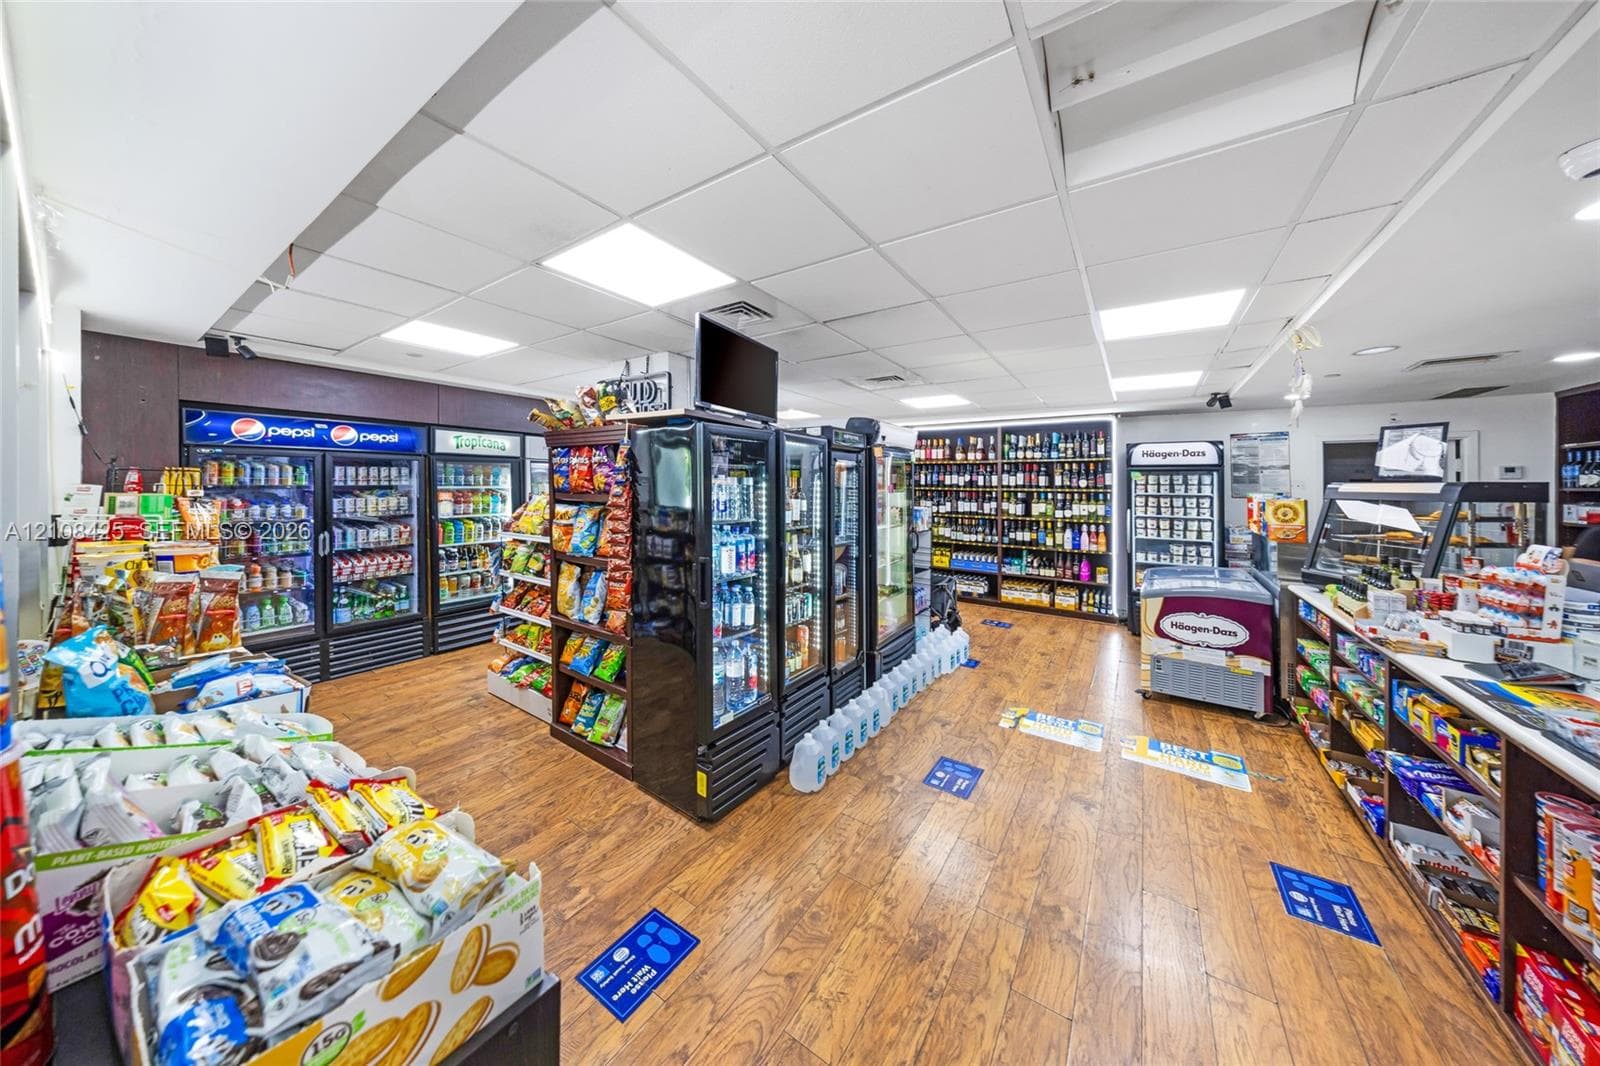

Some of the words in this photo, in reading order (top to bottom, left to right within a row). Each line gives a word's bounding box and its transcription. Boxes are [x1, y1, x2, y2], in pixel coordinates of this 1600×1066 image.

[268, 426, 315, 439] pepsi
[360, 432, 399, 444] pepsi
[453, 435, 506, 452] Tropicana
[1142, 449, 1206, 460] Häagen-Dazs
[1170, 620, 1239, 638] Häagen-Dazs
[1420, 858, 1469, 878] nutella
[630, 968, 657, 994] Please
[632, 964, 652, 982] Wait
[612, 981, 634, 1001] Here
